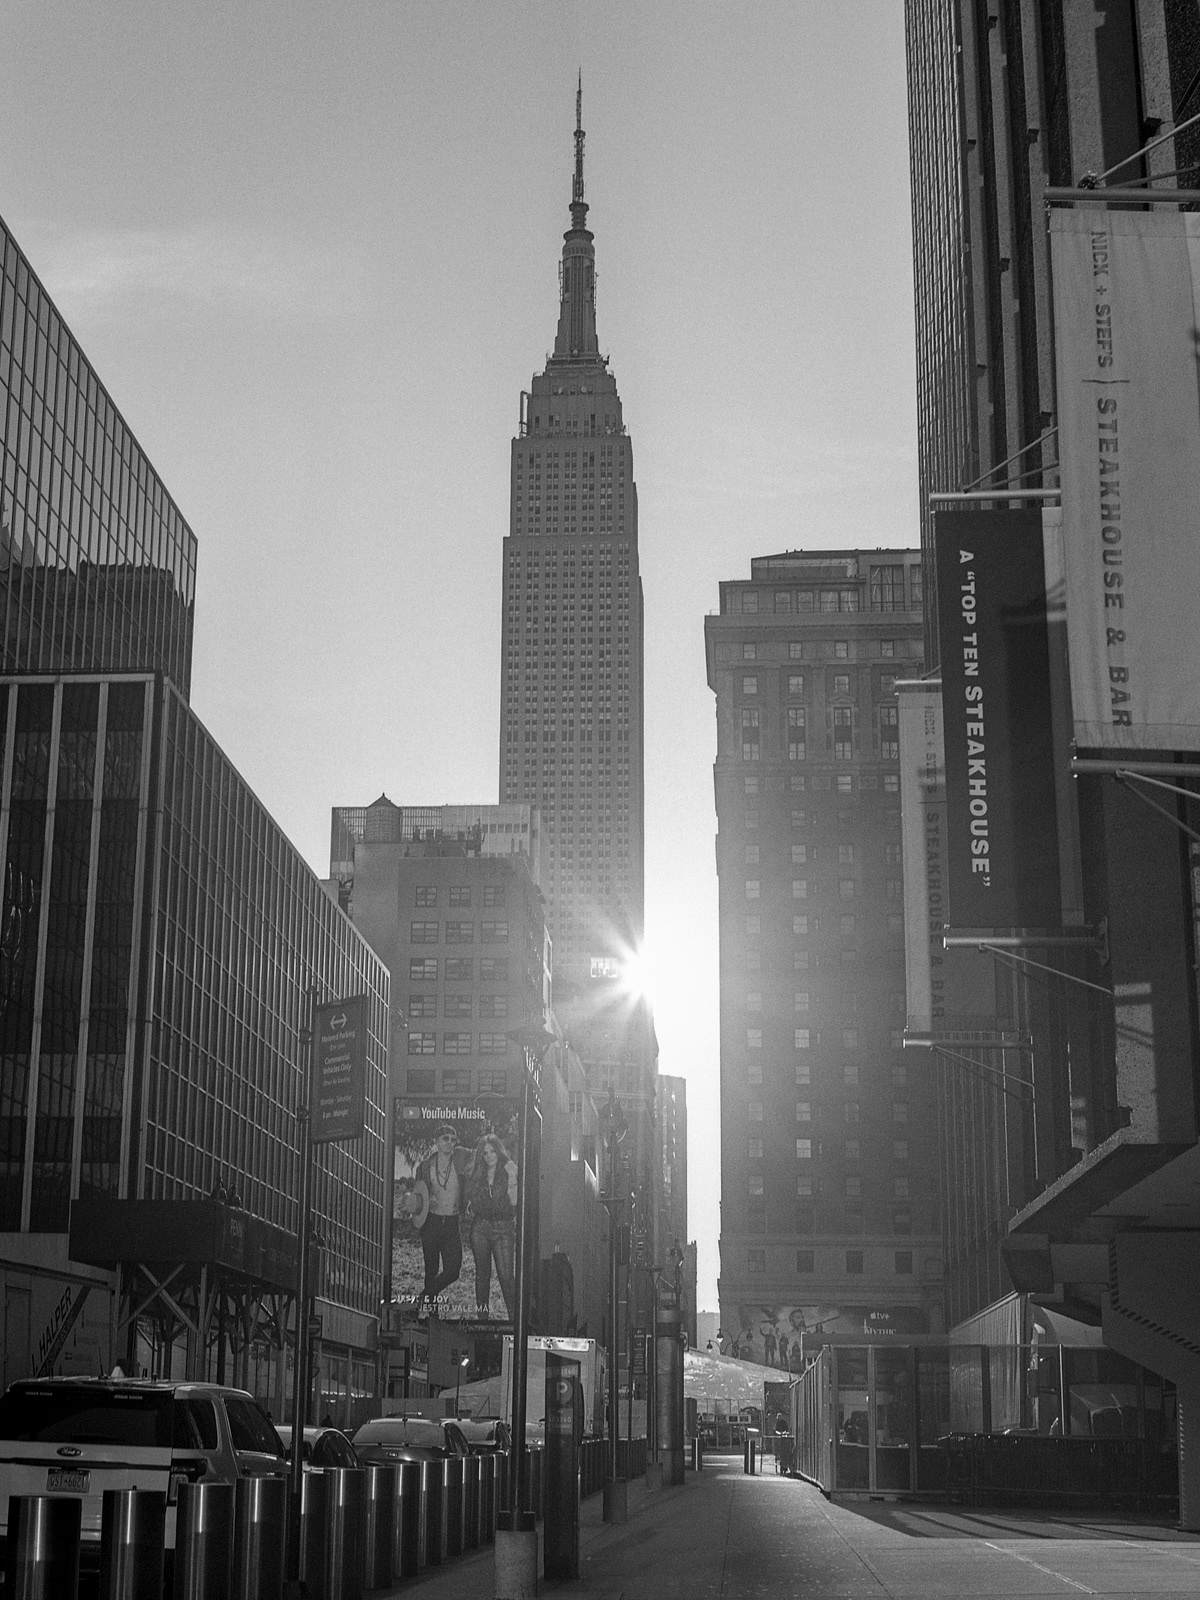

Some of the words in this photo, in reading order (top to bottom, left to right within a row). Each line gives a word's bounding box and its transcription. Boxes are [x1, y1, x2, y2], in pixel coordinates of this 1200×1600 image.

[1091, 231, 1110, 276] NICK
[1096, 284, 1106, 297] +
[1095, 303, 1113, 368] STEF'S
[1097, 397, 1126, 609] STEAKHOUSE
[959, 550, 974, 564] A
[963, 632, 979, 676] TEN
[1106, 627, 1127, 647] &
[1108, 665, 1133, 728] BAR
[925, 811, 943, 945] STEAKHOUSE
[421, 1107, 457, 1119] YouTube
[457, 1107, 485, 1119] Music
[423, 1294, 430, 1303] &
[432, 1294, 450, 1303] JOY
[451, 1304, 473, 1313] VALE
[38, 1285, 72, 1363] HALPER
